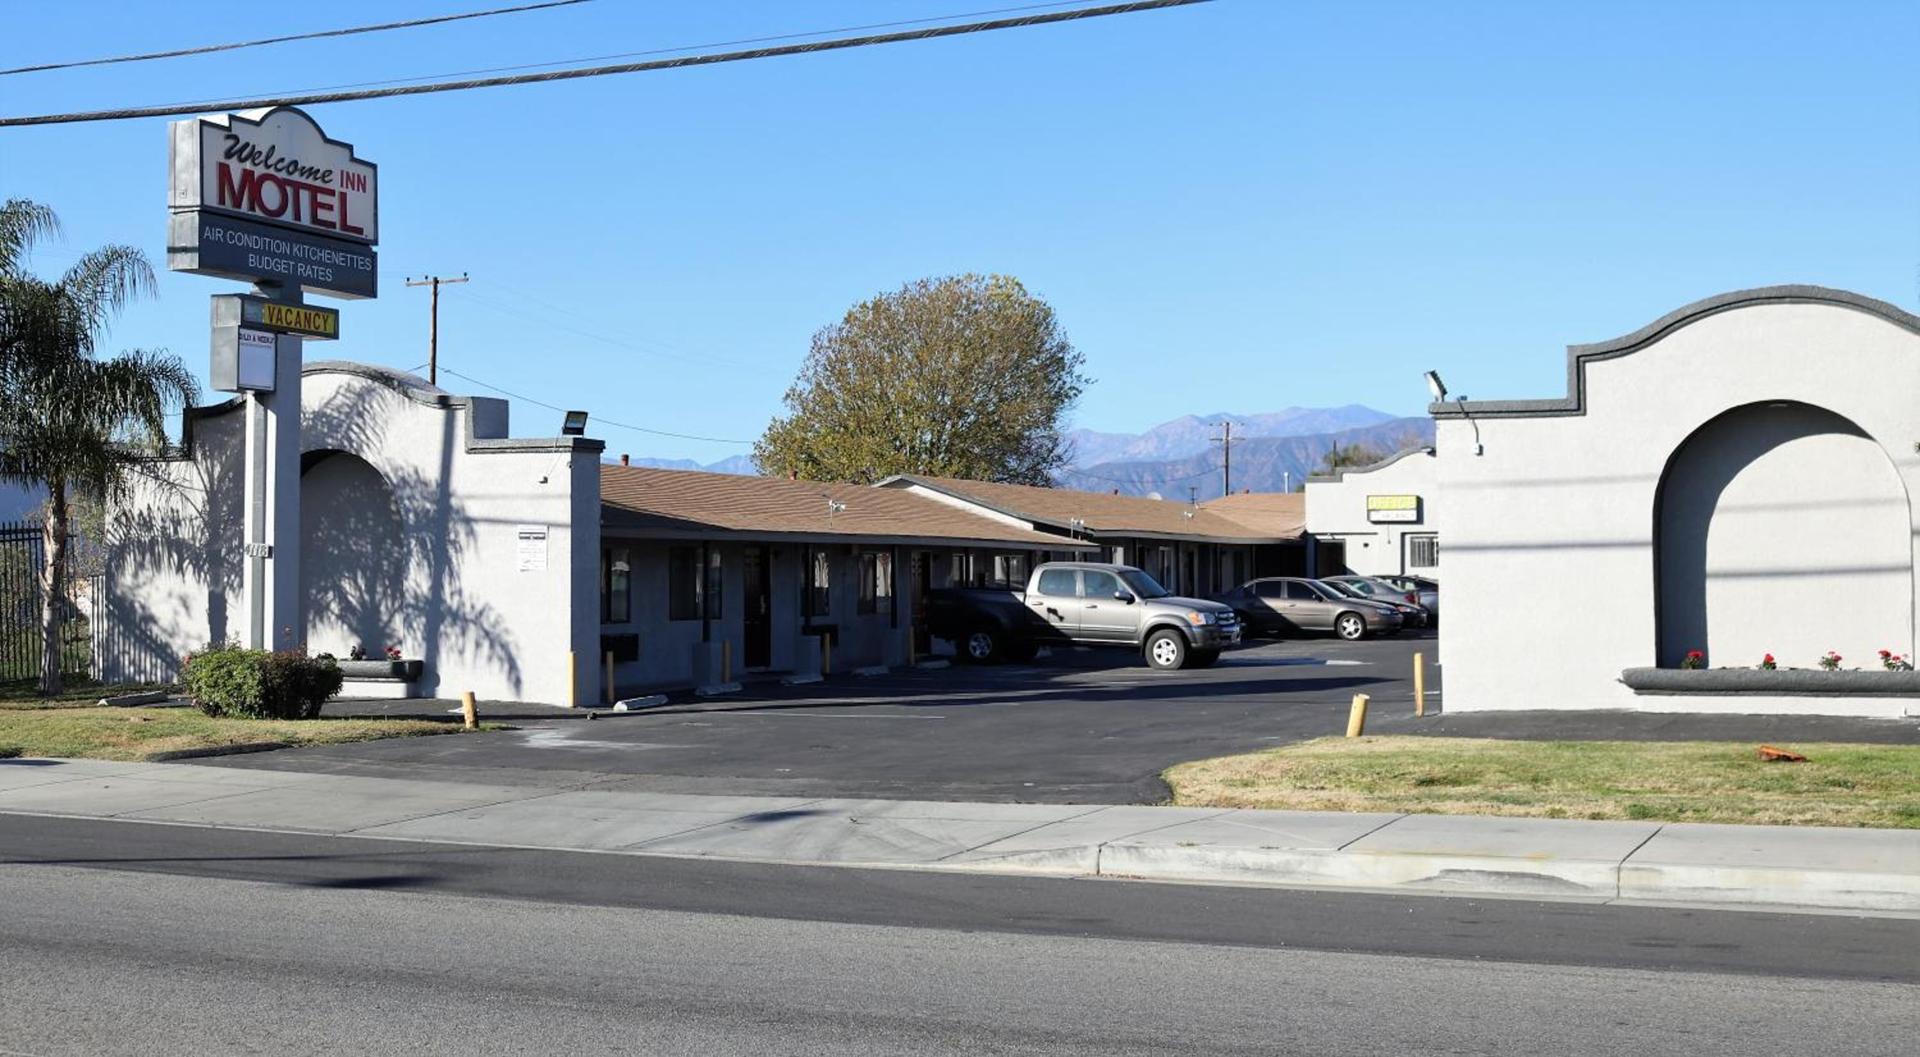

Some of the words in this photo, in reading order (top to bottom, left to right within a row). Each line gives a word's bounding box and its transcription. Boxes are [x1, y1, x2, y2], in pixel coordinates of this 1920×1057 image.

[223, 134, 334, 184] Welcome
[340, 170, 367, 193] INN
[216, 161, 364, 236] MOTEL
[203, 226, 224, 242] AIR
[226, 230, 291, 255] CONDITION
[292, 244, 372, 271] KITCHENETTES
[249, 254, 294, 277] BUDGET
[297, 264, 333, 282] RATES
[267, 305, 330, 331] VACANCY
